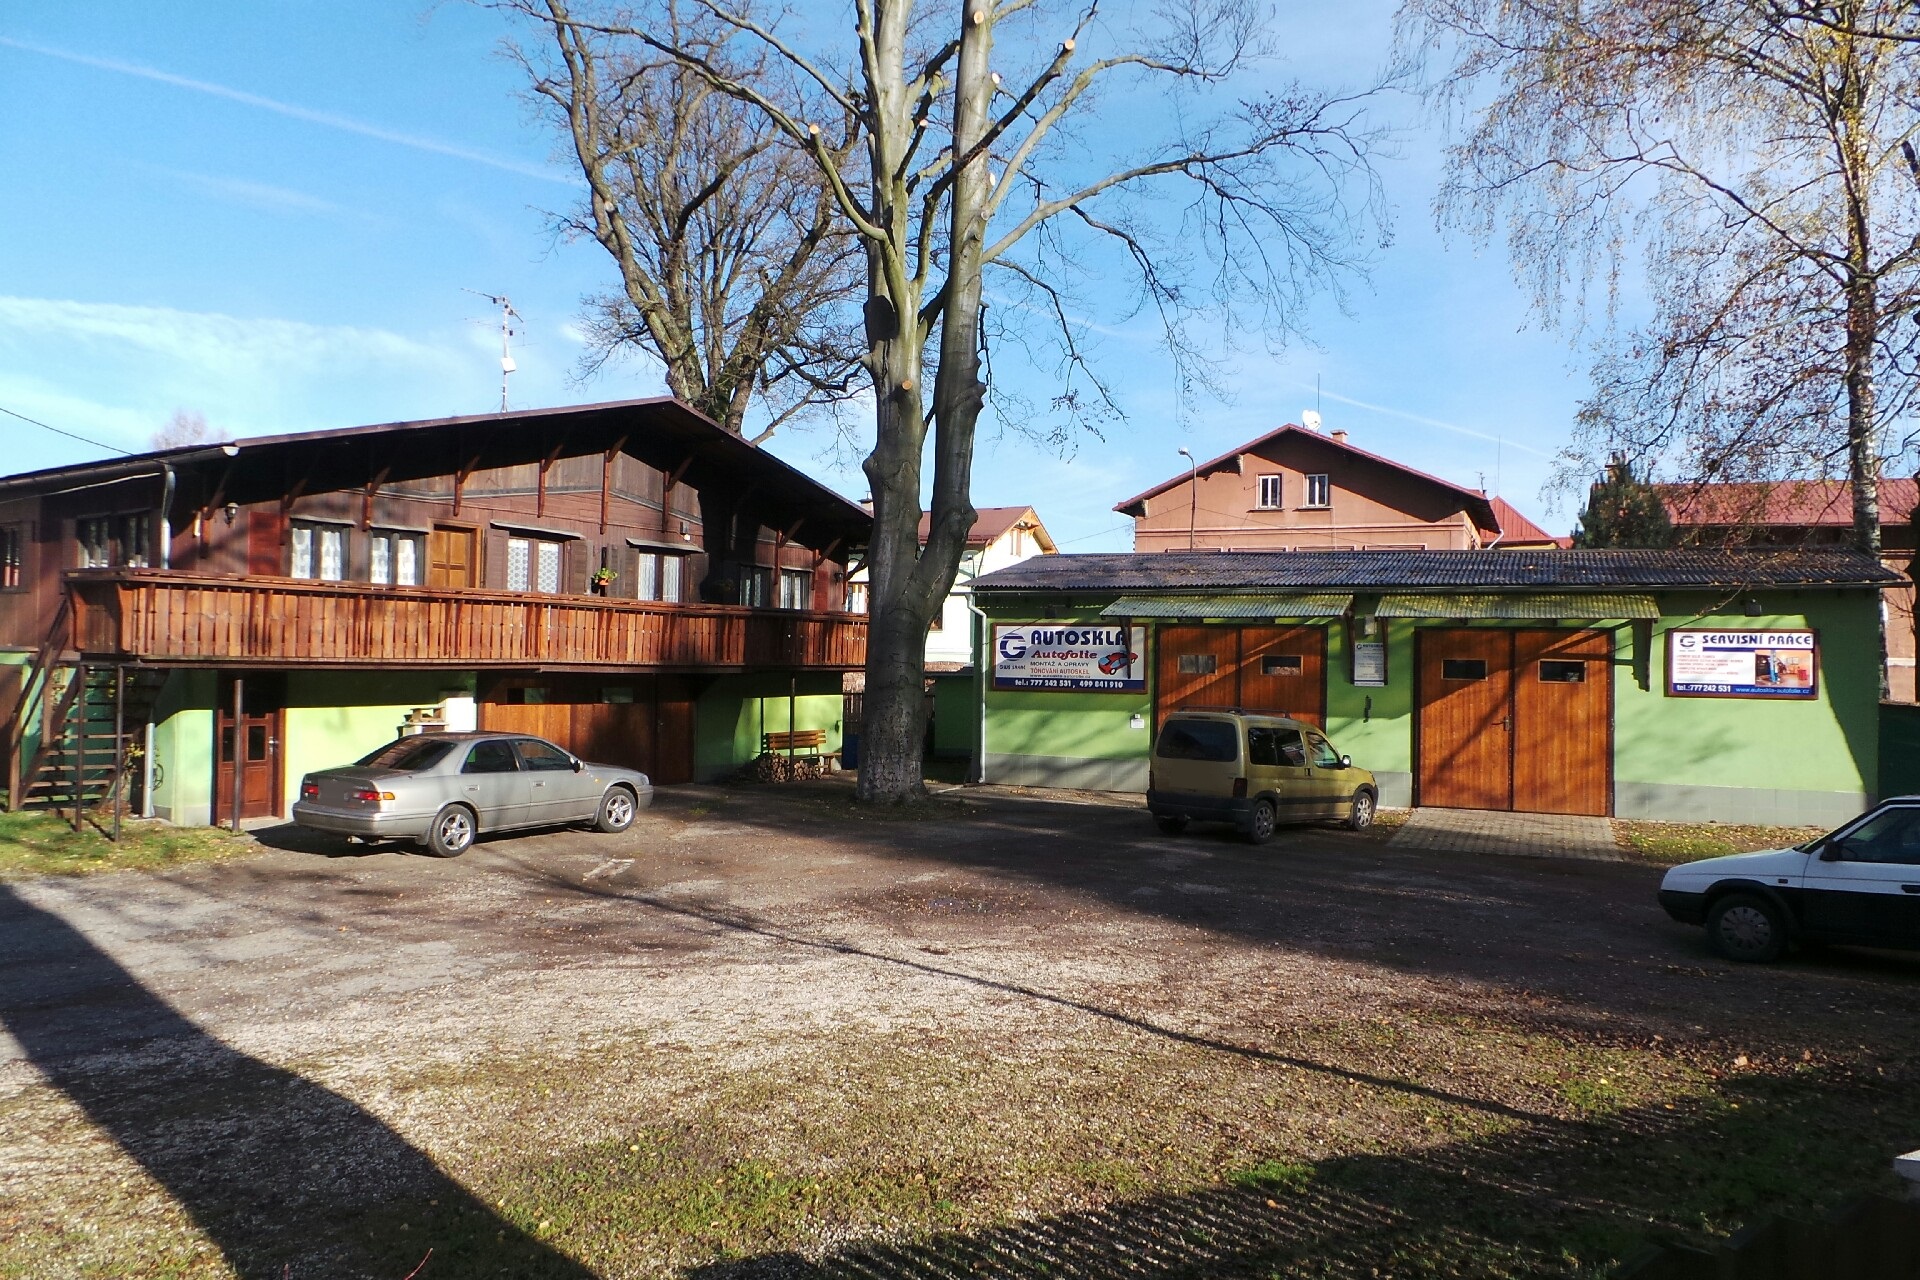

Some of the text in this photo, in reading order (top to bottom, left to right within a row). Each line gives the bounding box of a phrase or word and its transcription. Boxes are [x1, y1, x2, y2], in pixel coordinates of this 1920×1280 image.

[1031, 630, 1125, 645] AUTOSKLA
[1702, 634, 1811, 646] SERVISNÍ PRÁCE
[1031, 650, 1097, 660] Autofolie
[1079, 680, 1093, 688] 499
[1109, 681, 1124, 689] 910
[1718, 685, 1731, 693] 531
